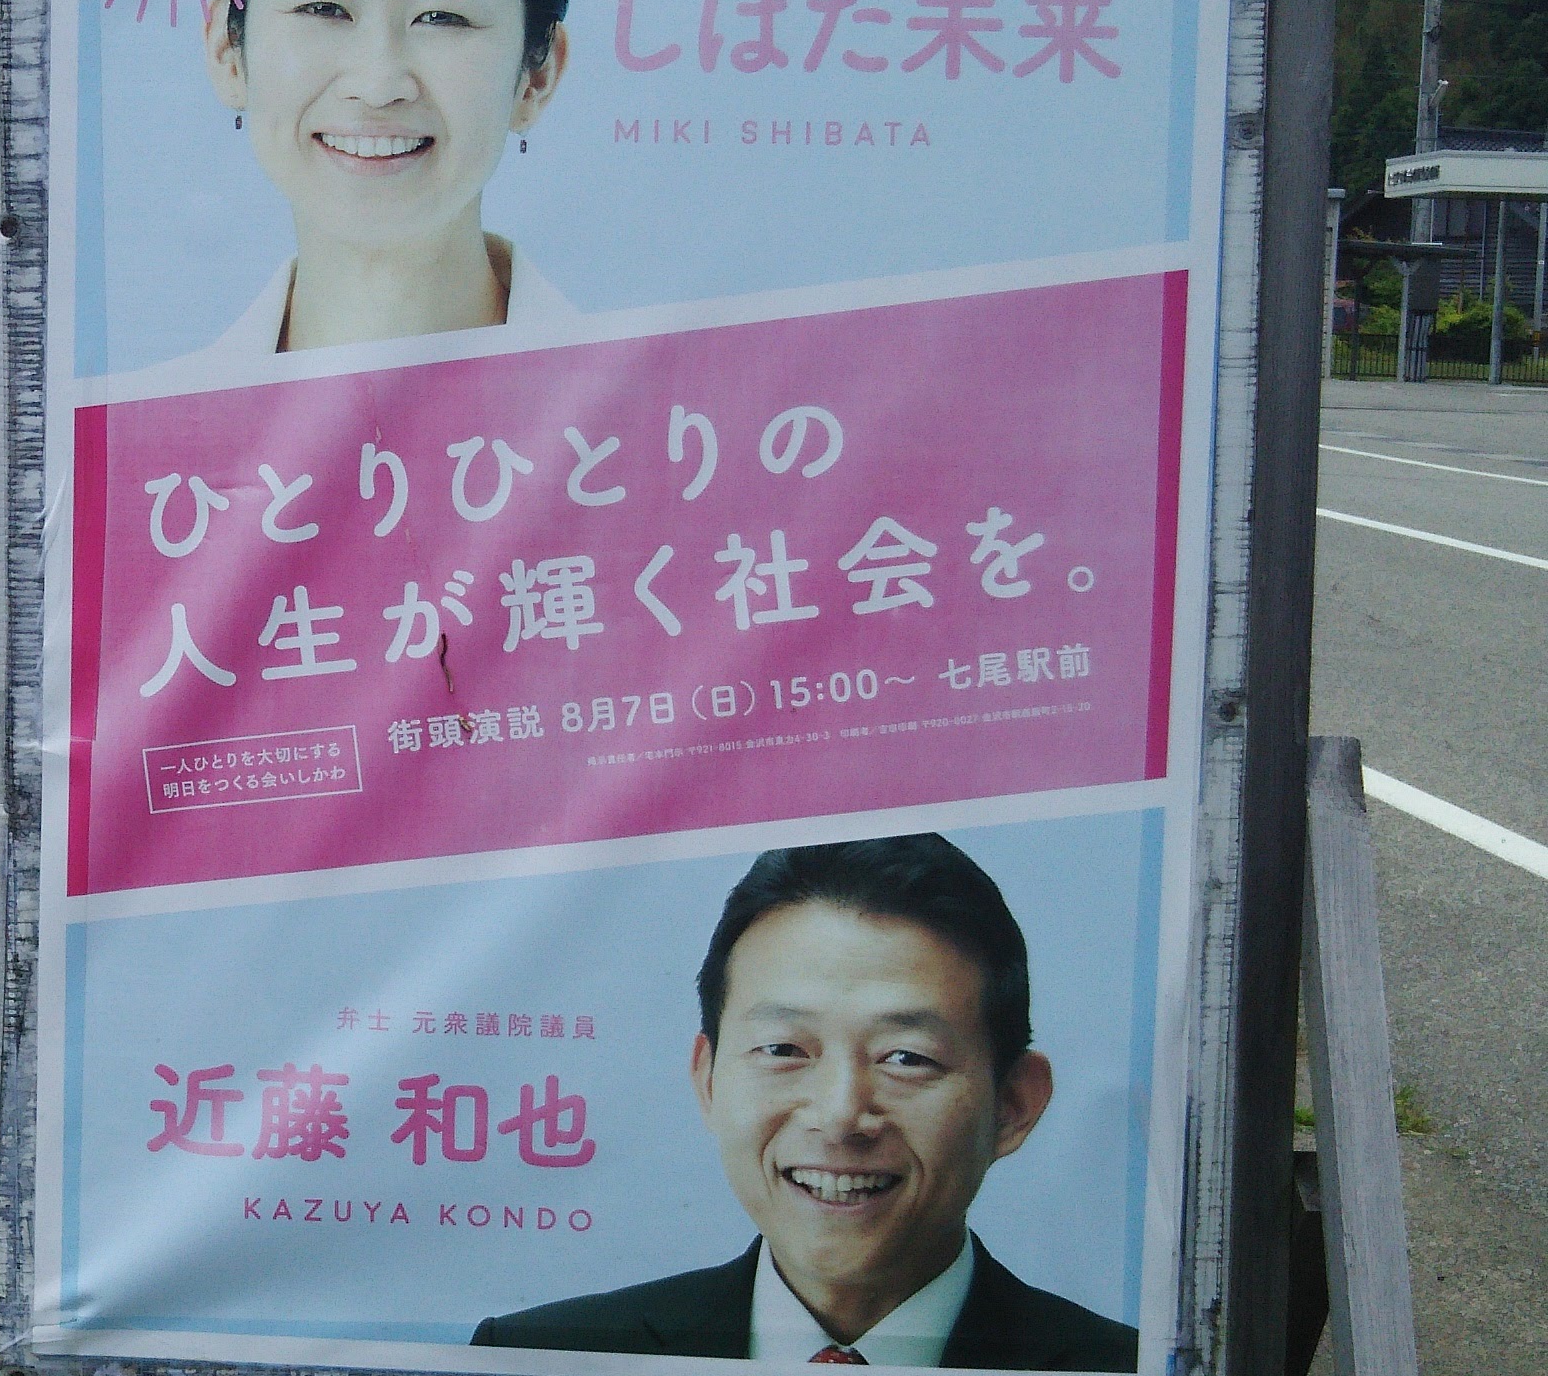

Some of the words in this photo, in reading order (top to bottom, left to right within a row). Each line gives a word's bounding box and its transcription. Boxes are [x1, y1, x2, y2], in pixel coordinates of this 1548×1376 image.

[614, 119, 711, 145] MIKI
[741, 120, 932, 147] SHIBATA
[144, 405, 844, 560] ひとりひとりの
[140, 507, 1096, 699] 人生が輝く社会を。
[388, 704, 545, 754] 街頭演説
[938, 643, 1090, 689] 七尾駅前
[147, 1063, 350, 1161] 近藤
[390, 1073, 596, 1167] 和也
[244, 1197, 410, 1225] KAZUYA
[440, 1204, 593, 1233] KONDO
